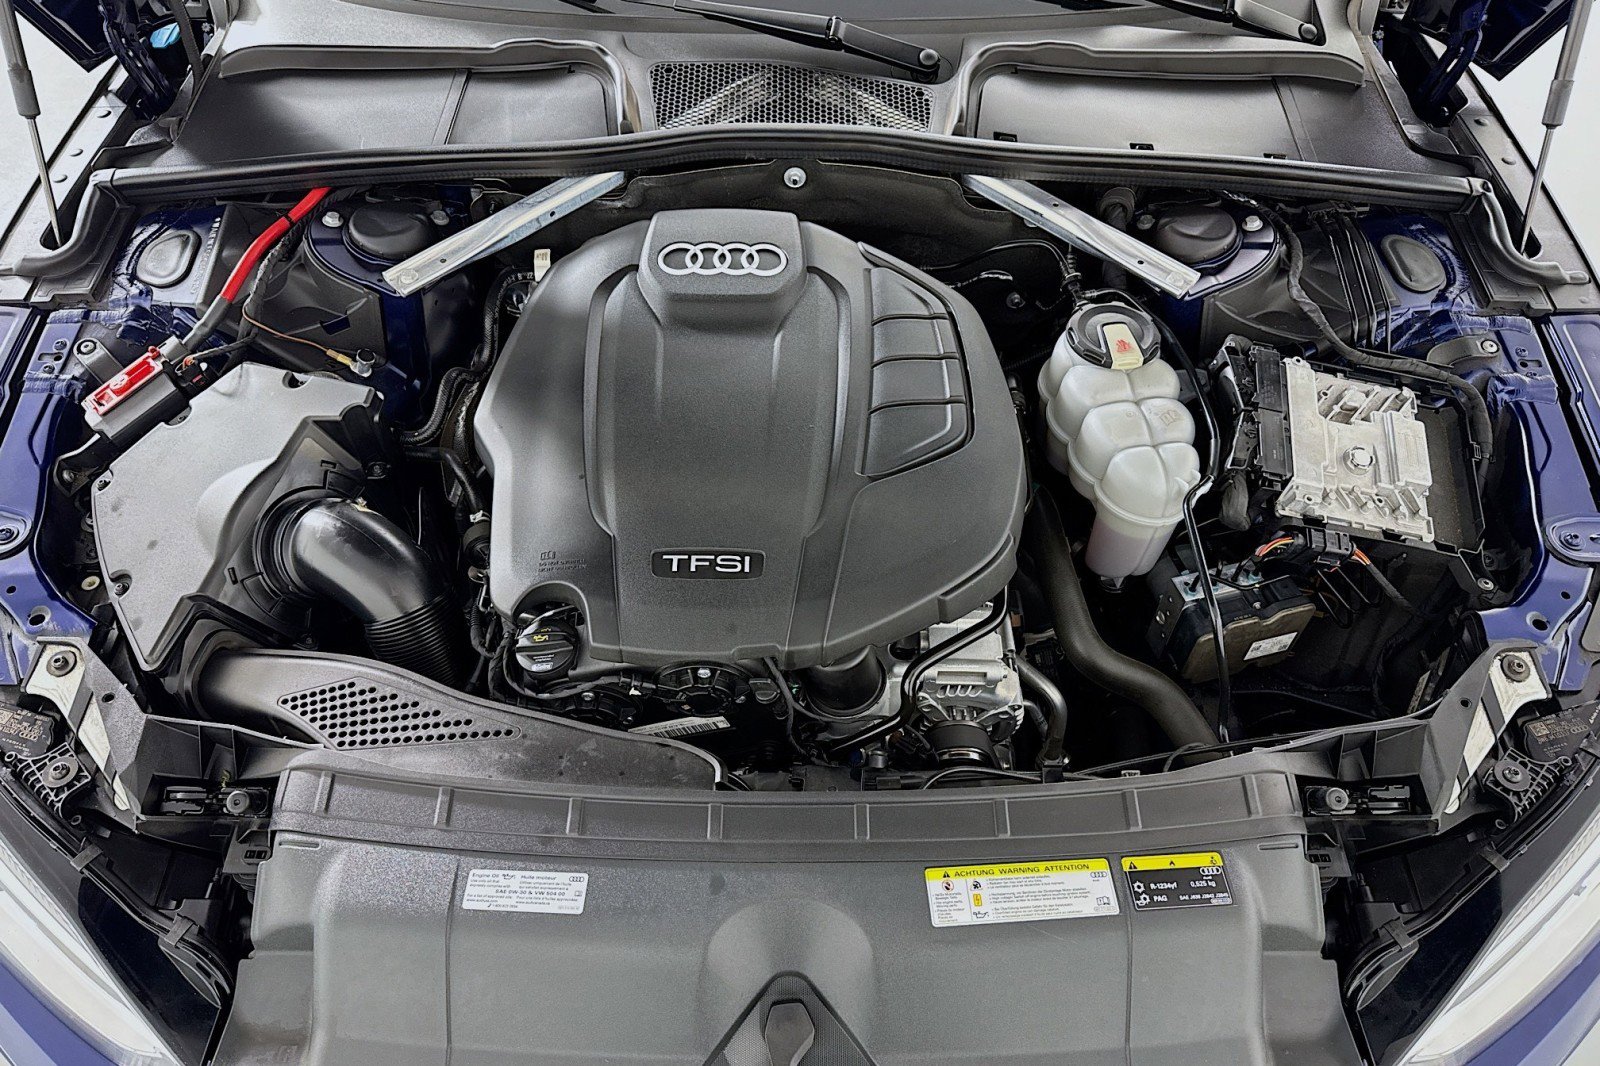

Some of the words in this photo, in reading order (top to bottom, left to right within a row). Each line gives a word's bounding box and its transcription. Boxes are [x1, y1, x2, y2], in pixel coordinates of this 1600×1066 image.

[662, 555, 751, 573] TFSI
[954, 868, 995, 877] ACHTUNG
[998, 866, 1040, 875] WARNING
[1044, 863, 1090, 872] ATTENTION
[1149, 881, 1178, 890] R-1234yf
[1208, 880, 1216, 888] kg
[1153, 894, 1168, 902] PAG
